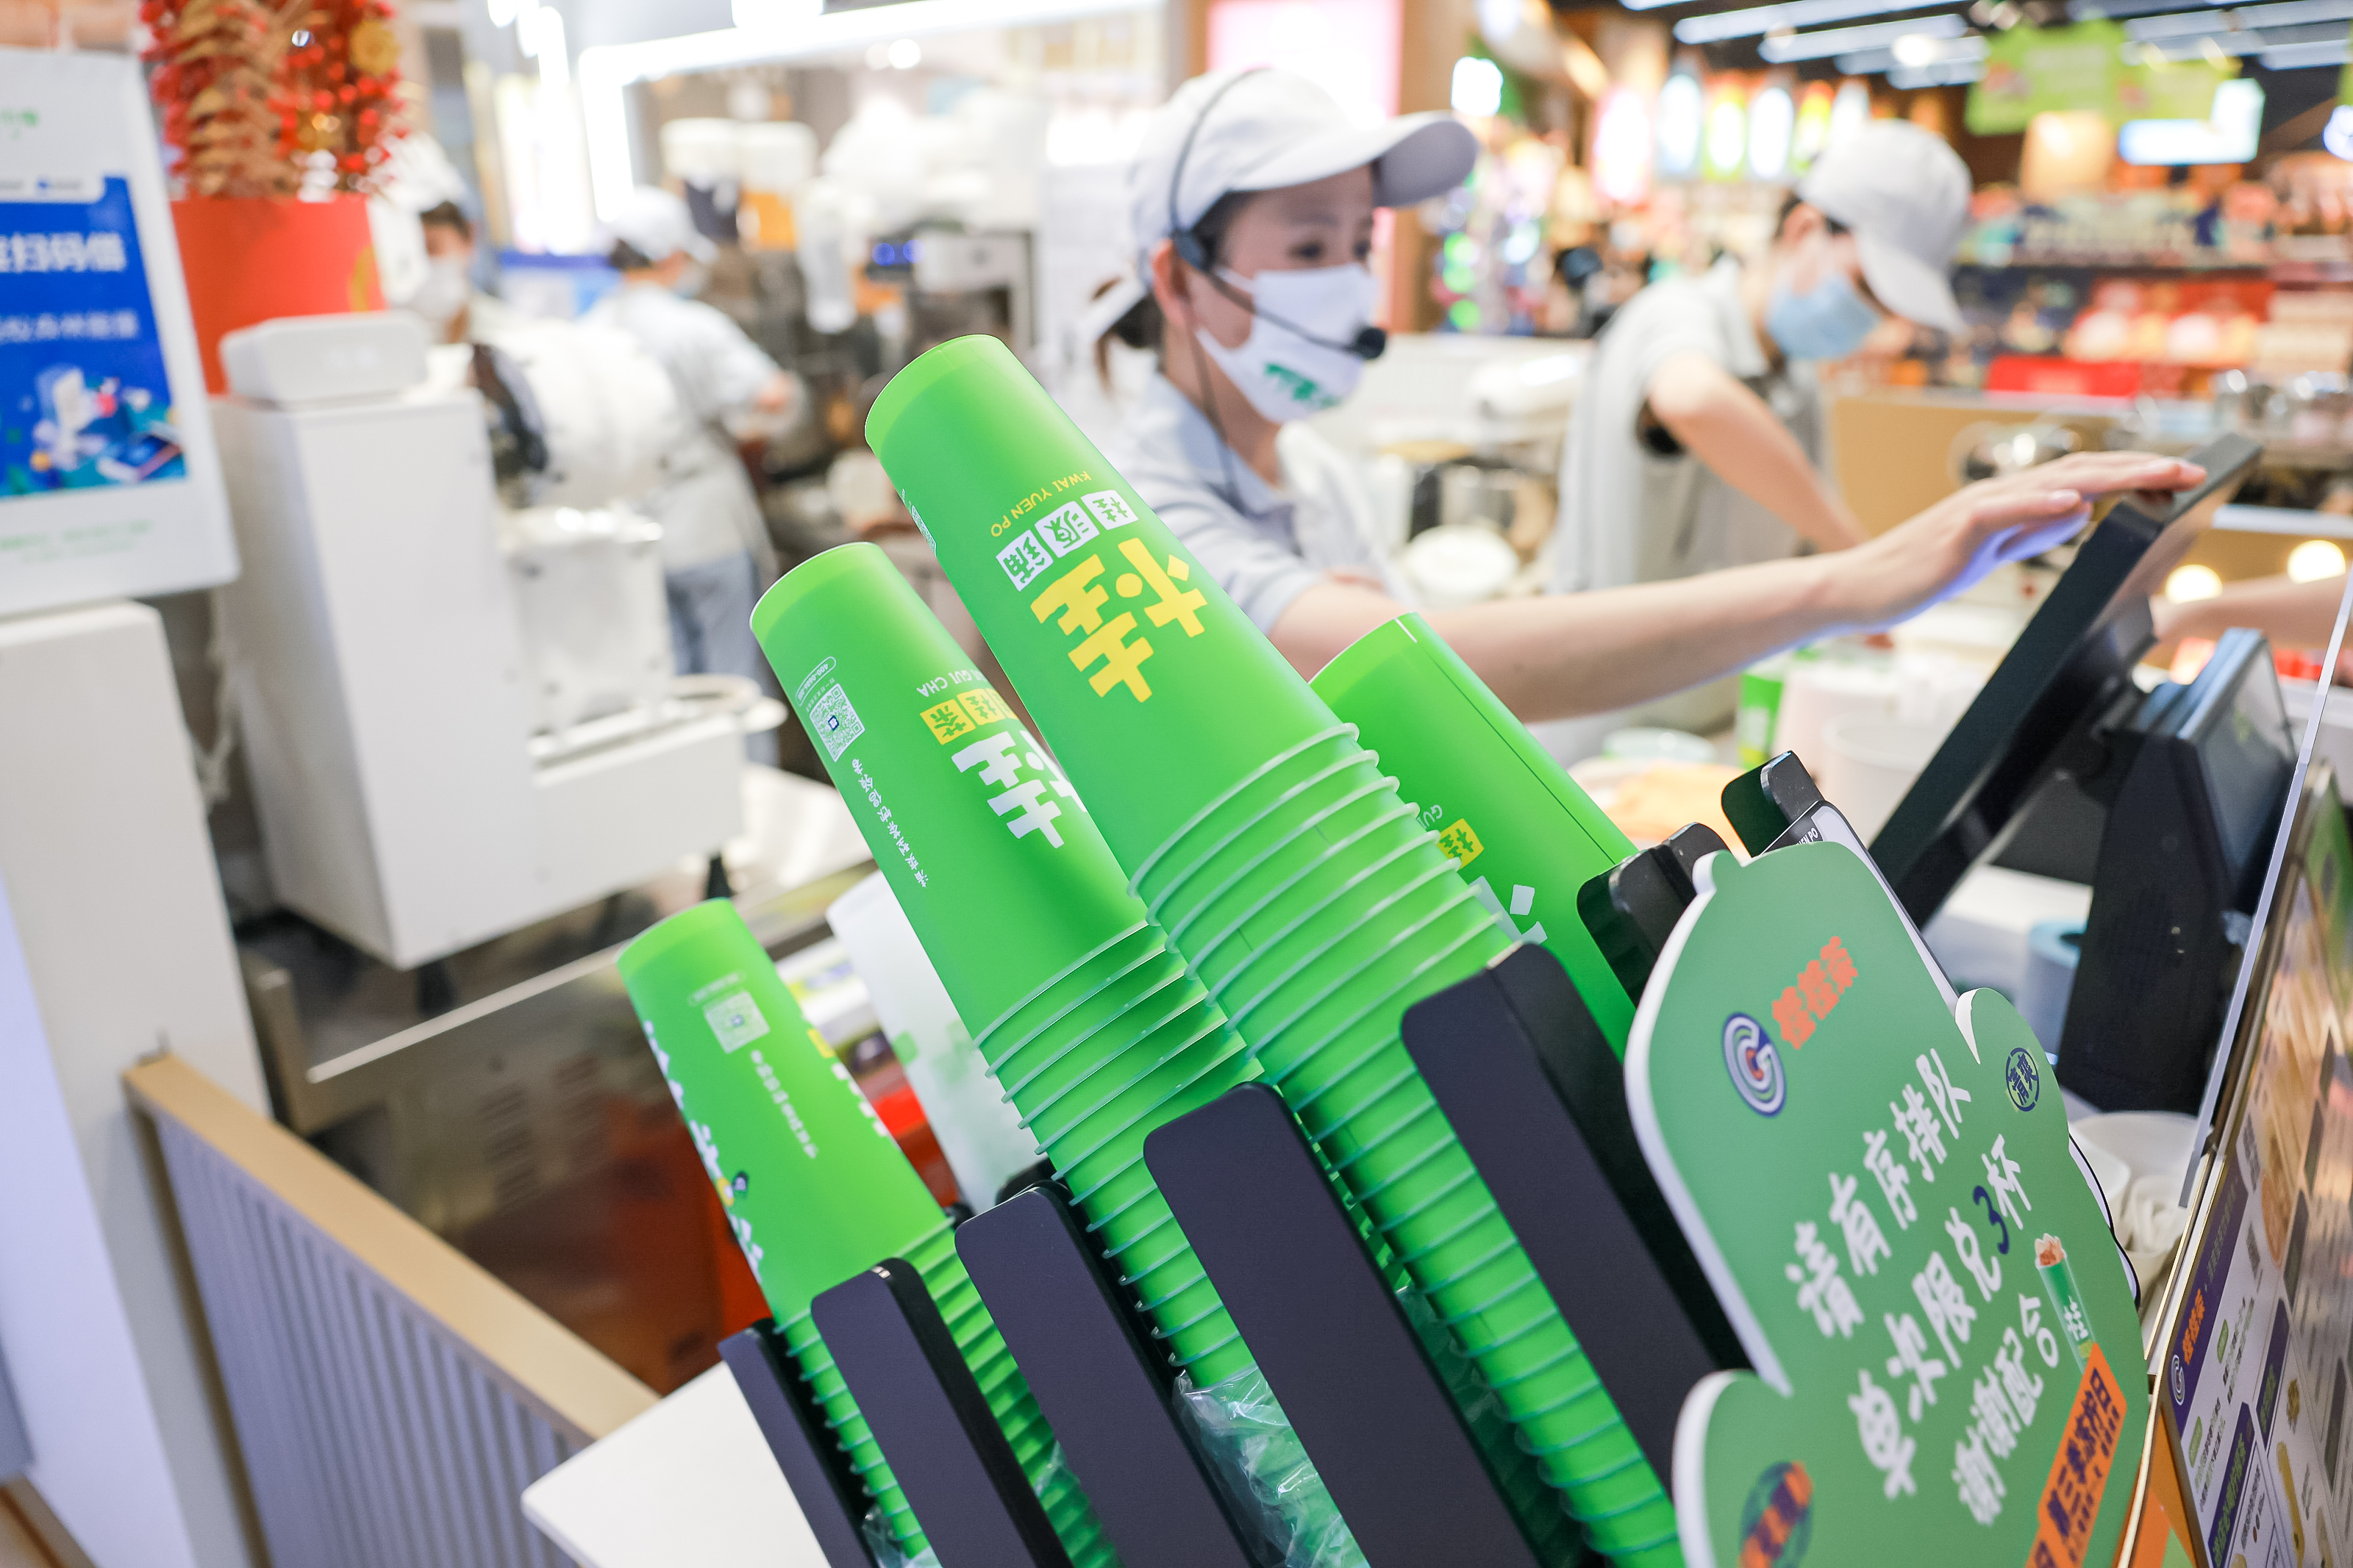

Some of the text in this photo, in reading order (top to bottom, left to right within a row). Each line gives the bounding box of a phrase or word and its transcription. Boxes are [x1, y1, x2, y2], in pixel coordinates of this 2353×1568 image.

[990, 470, 1092, 537] KWAI YUEN PO
[1030, 537, 1208, 703] 桂
[916, 676, 949, 698] CHA
[949, 670, 972, 685] GUI
[851, 758, 929, 888] 清爽型茶饮倡领者
[1417, 804, 1443, 829] GUI
[2007, 1050, 2038, 1107] 清爽
[1785, 1048, 1972, 1339] 请有序排队
[1952, 1293, 2060, 1527] 谢谢配合
